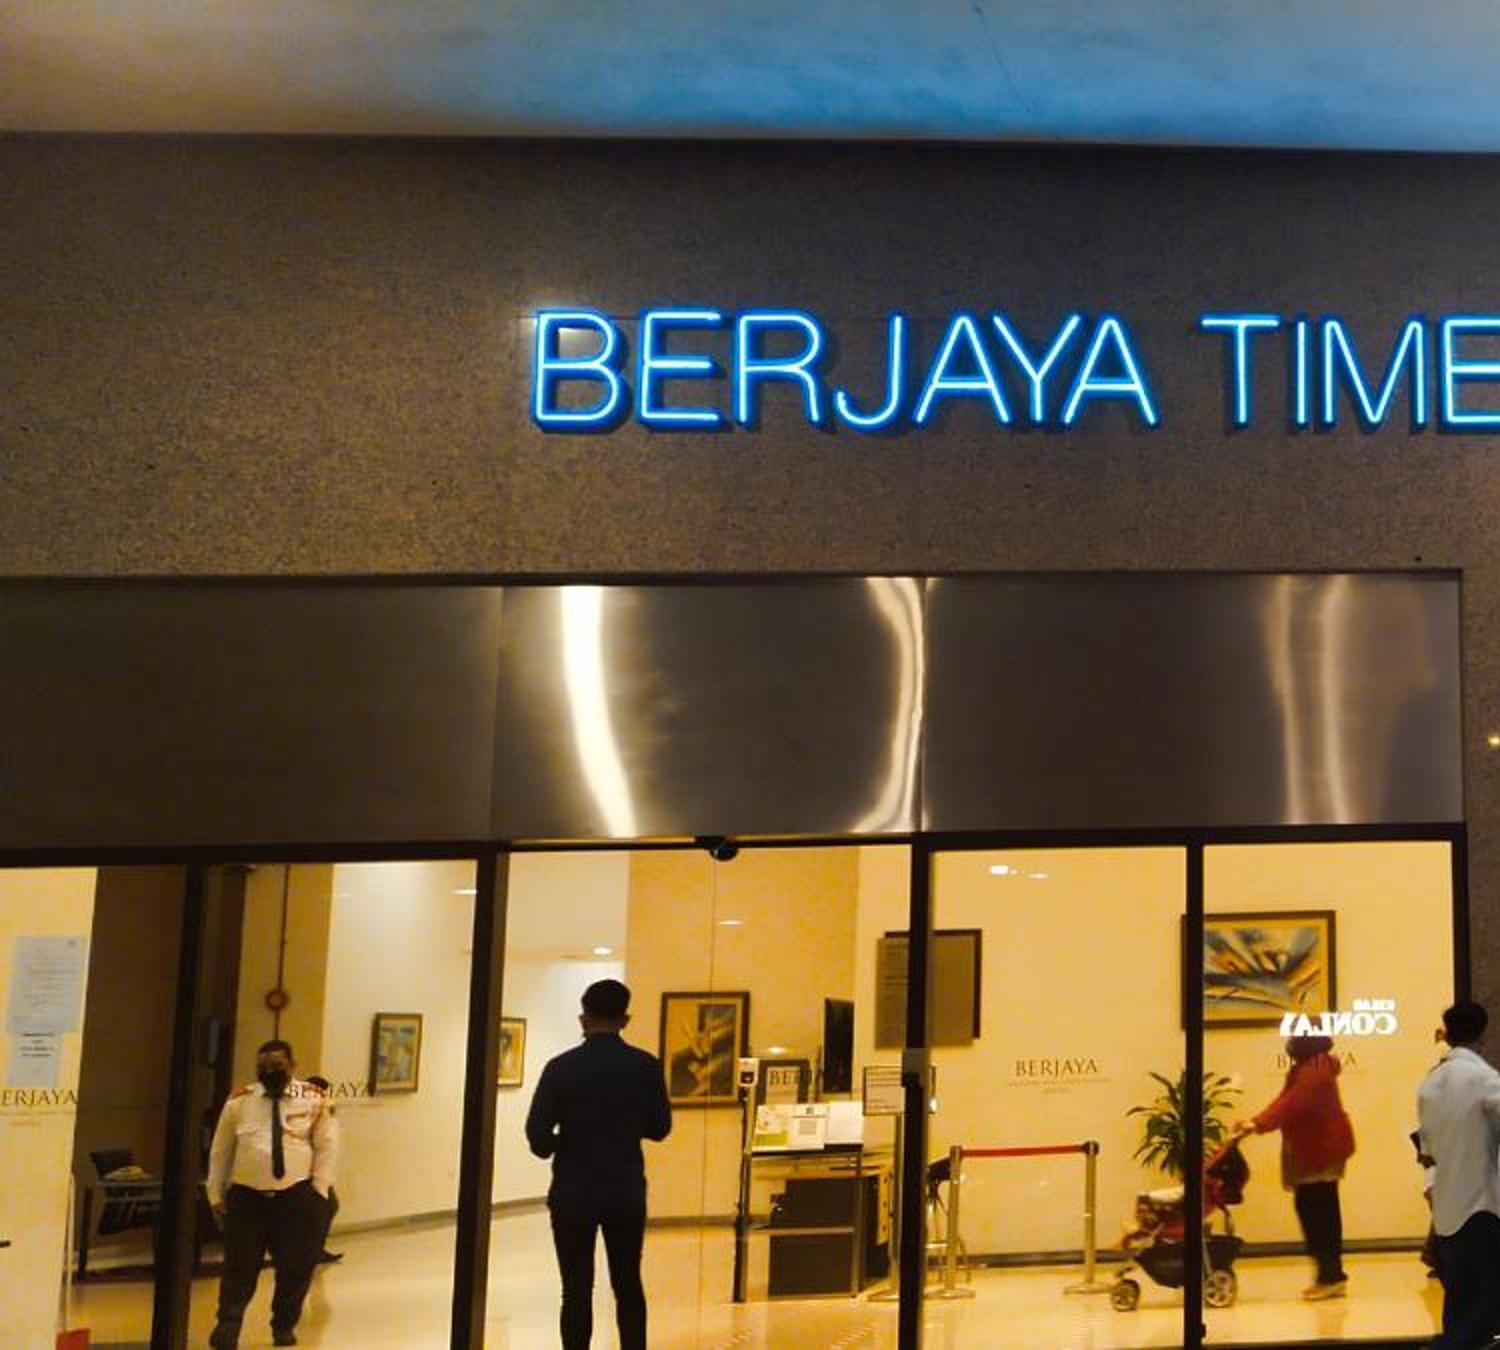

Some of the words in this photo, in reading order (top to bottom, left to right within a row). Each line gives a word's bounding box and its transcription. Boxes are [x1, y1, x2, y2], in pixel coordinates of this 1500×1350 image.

[531, 309, 1160, 432] BERJAYA
[1015, 1059, 1098, 1078] BERJAYA
[0, 1088, 79, 1105] ERJAYA
